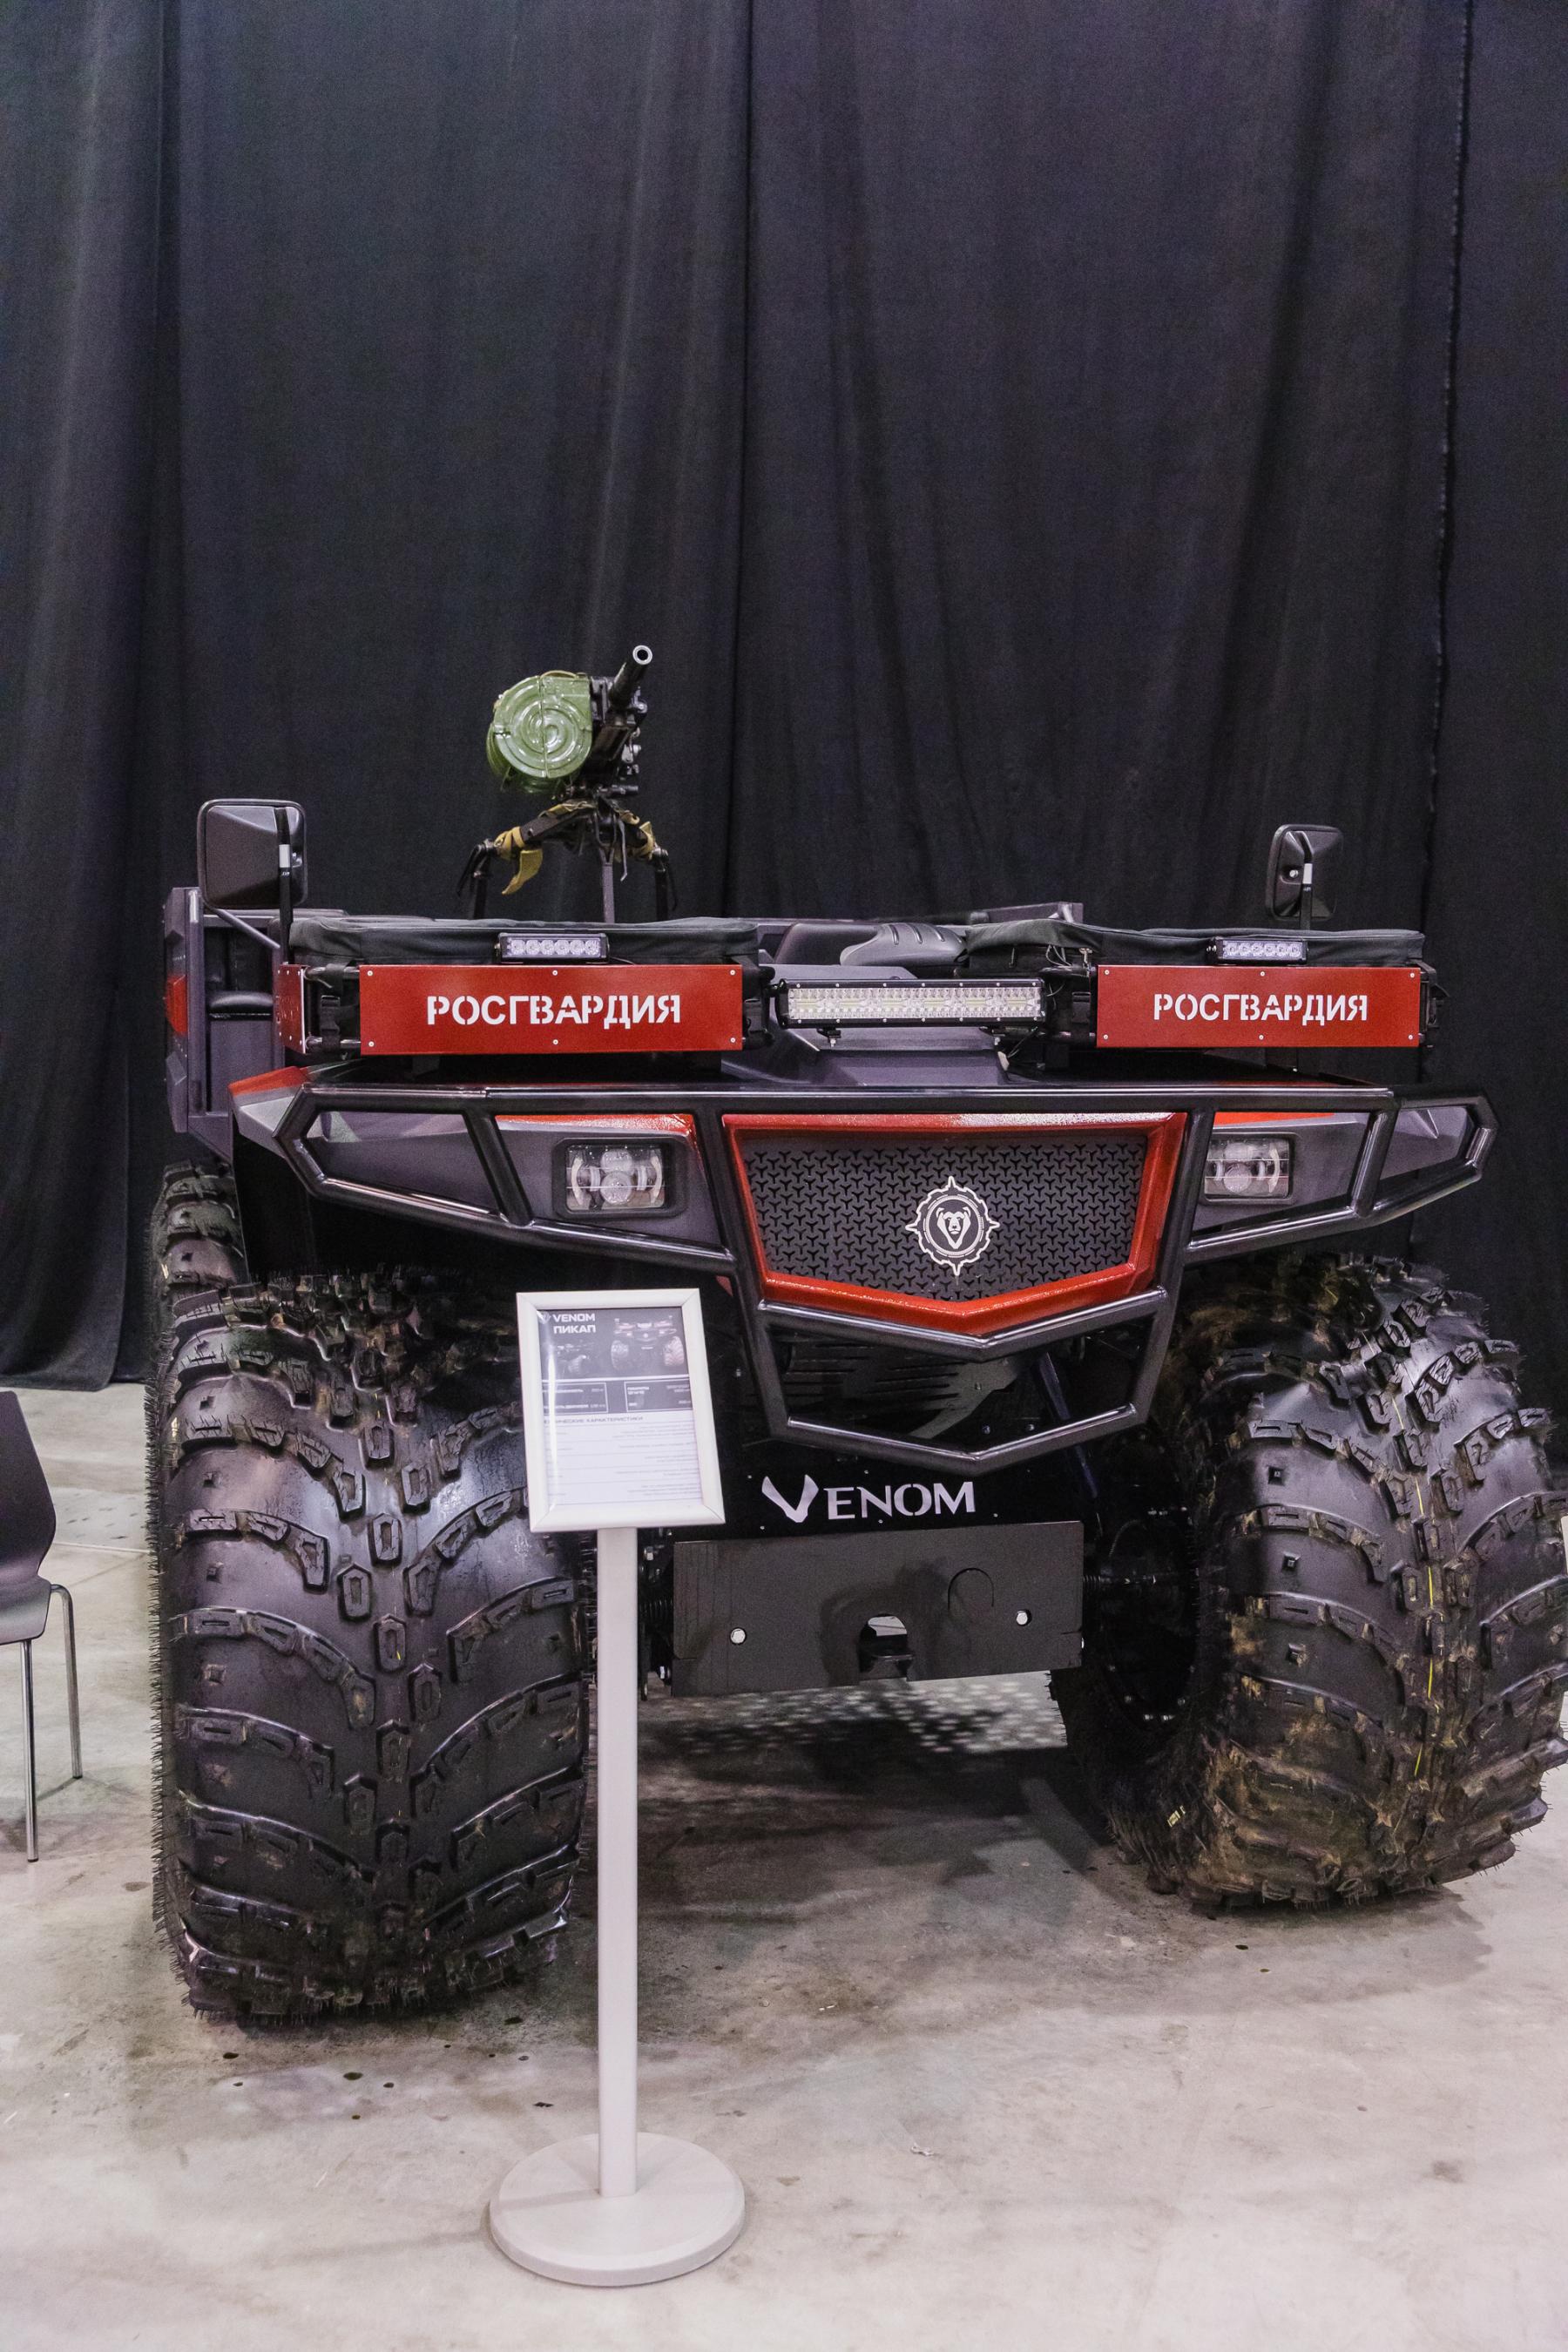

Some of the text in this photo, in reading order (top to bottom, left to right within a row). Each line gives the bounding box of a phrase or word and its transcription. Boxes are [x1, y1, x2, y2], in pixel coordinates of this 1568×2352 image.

[427, 995, 680, 1030] РОСГВАРДИЯ
[1153, 993, 1368, 1026] РОСГВАРДИЯ
[552, 1314, 596, 1322] VENOM
[553, 1325, 597, 1334] ПИКАП
[761, 1474, 976, 1524] VENOM
